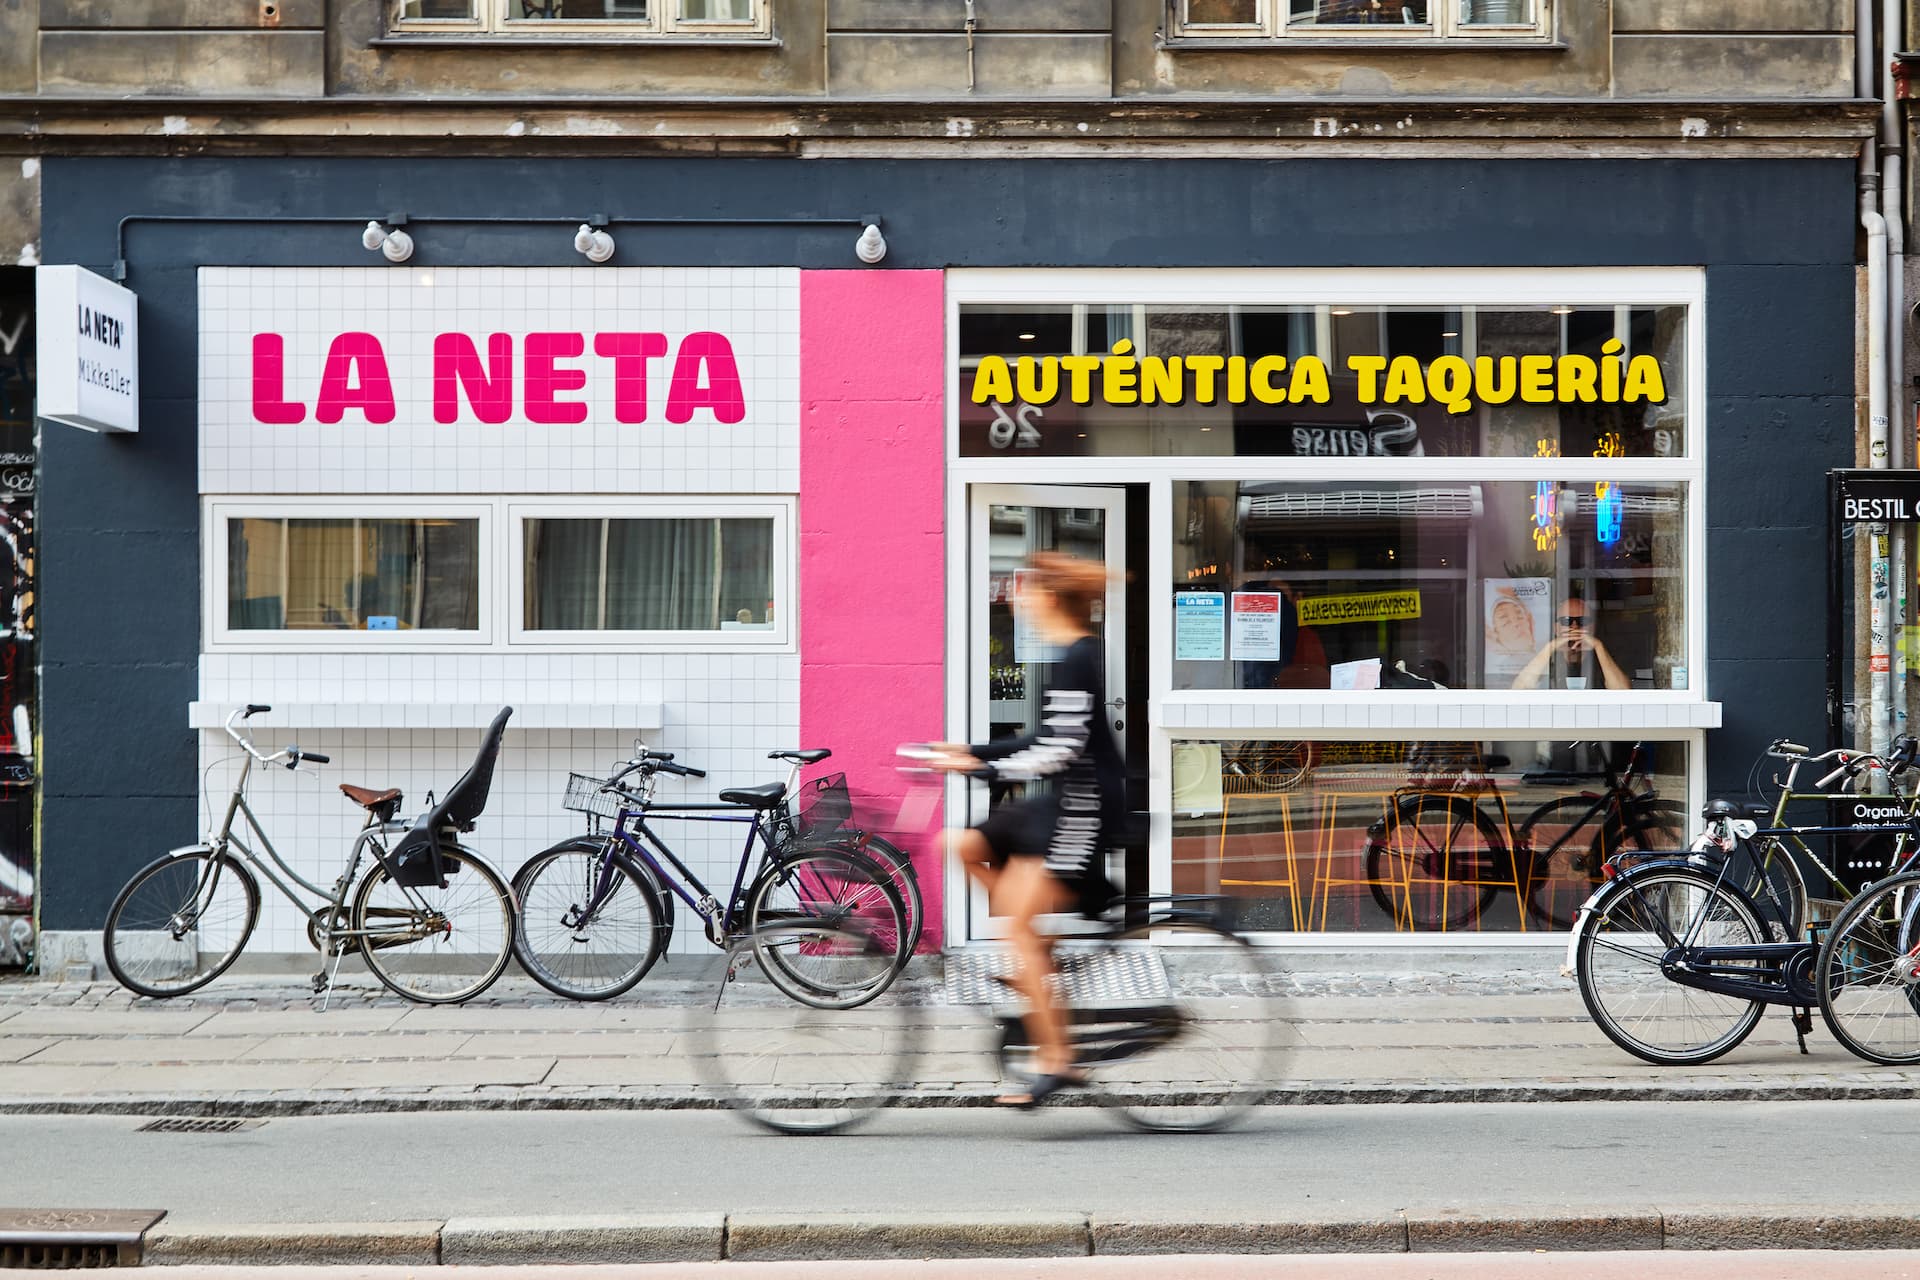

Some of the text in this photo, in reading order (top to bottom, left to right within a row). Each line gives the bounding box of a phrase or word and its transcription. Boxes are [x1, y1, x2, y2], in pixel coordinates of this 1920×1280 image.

[79, 304, 91, 339] LA
[78, 357, 131, 396] Mikkeller
[252, 331, 746, 424] LA NETA
[970, 337, 1667, 415] AUTÉNTICA TAQUERÍA
[1844, 498, 1910, 519] BESTIL
